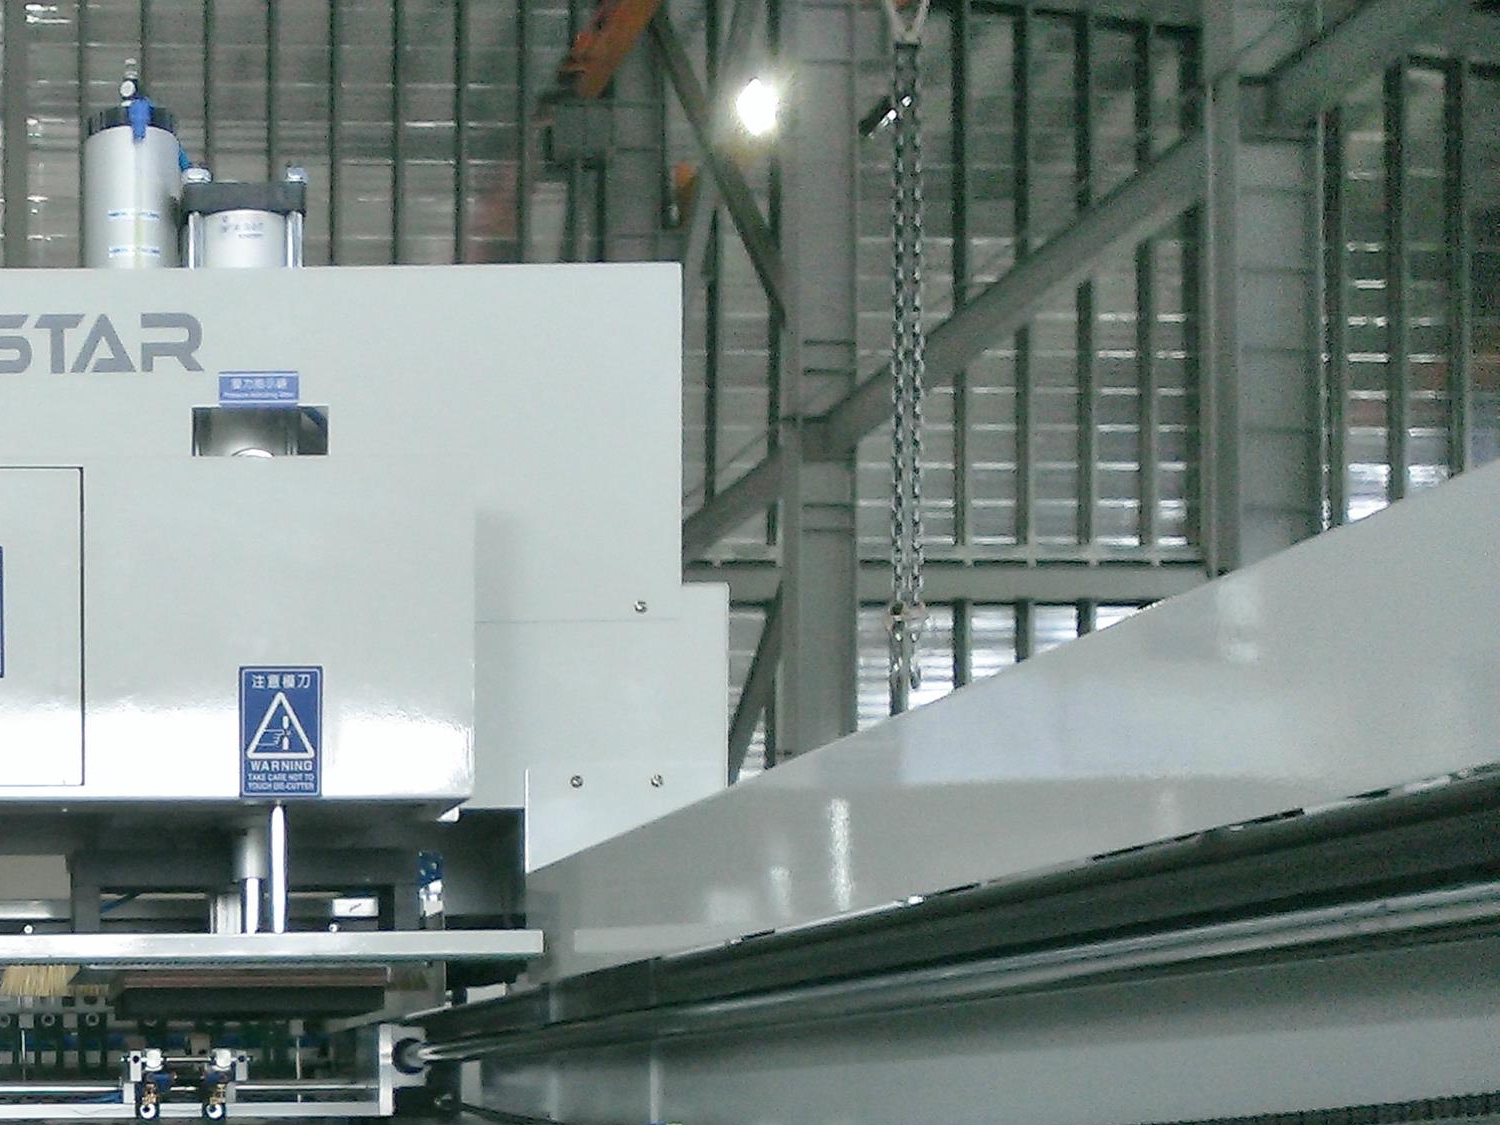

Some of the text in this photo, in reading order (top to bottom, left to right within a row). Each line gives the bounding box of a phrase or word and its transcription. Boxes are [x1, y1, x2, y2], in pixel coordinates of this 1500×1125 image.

[250, 760, 313, 771] WARNING
[248, 773, 315, 781] TAKE CARE NOT TO
